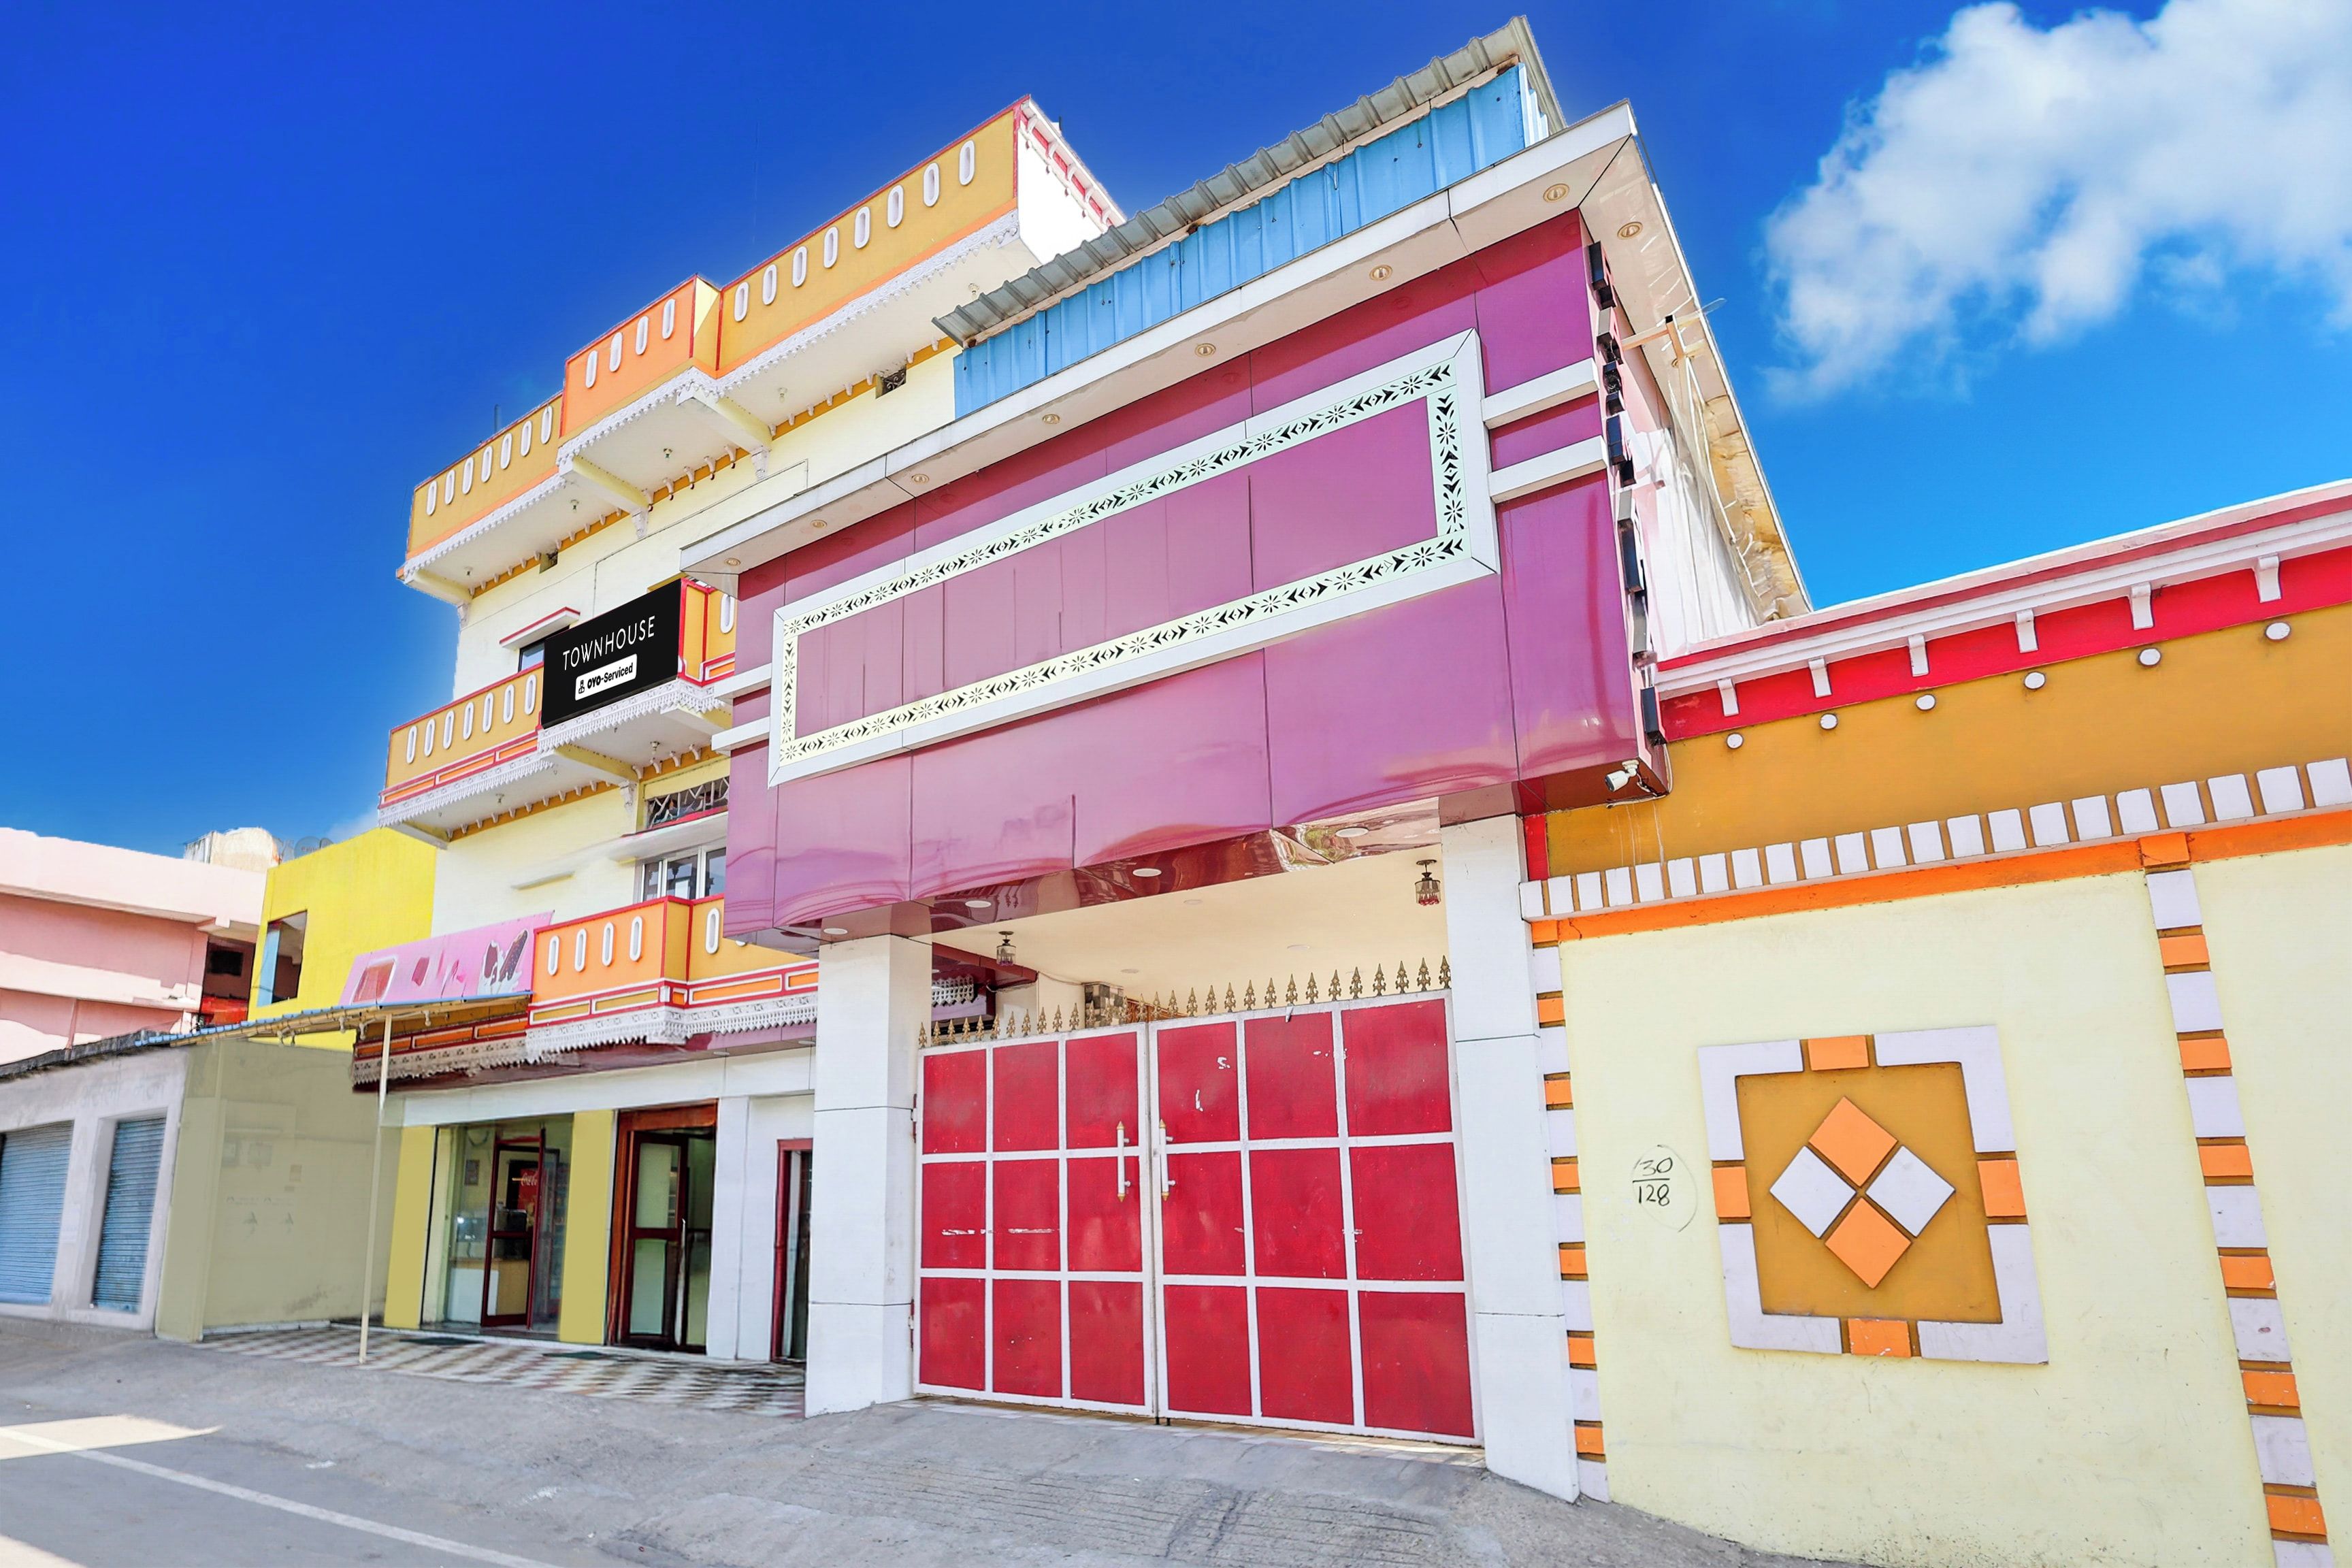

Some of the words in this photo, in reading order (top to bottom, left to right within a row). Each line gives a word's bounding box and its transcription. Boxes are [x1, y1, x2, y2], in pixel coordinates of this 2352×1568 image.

[563, 615, 655, 671] TOWNHOUSE
[587, 662, 634, 689] OYO-Serviced
[1639, 1157, 1673, 1176] 30
[1638, 1183, 1670, 1207] 128
